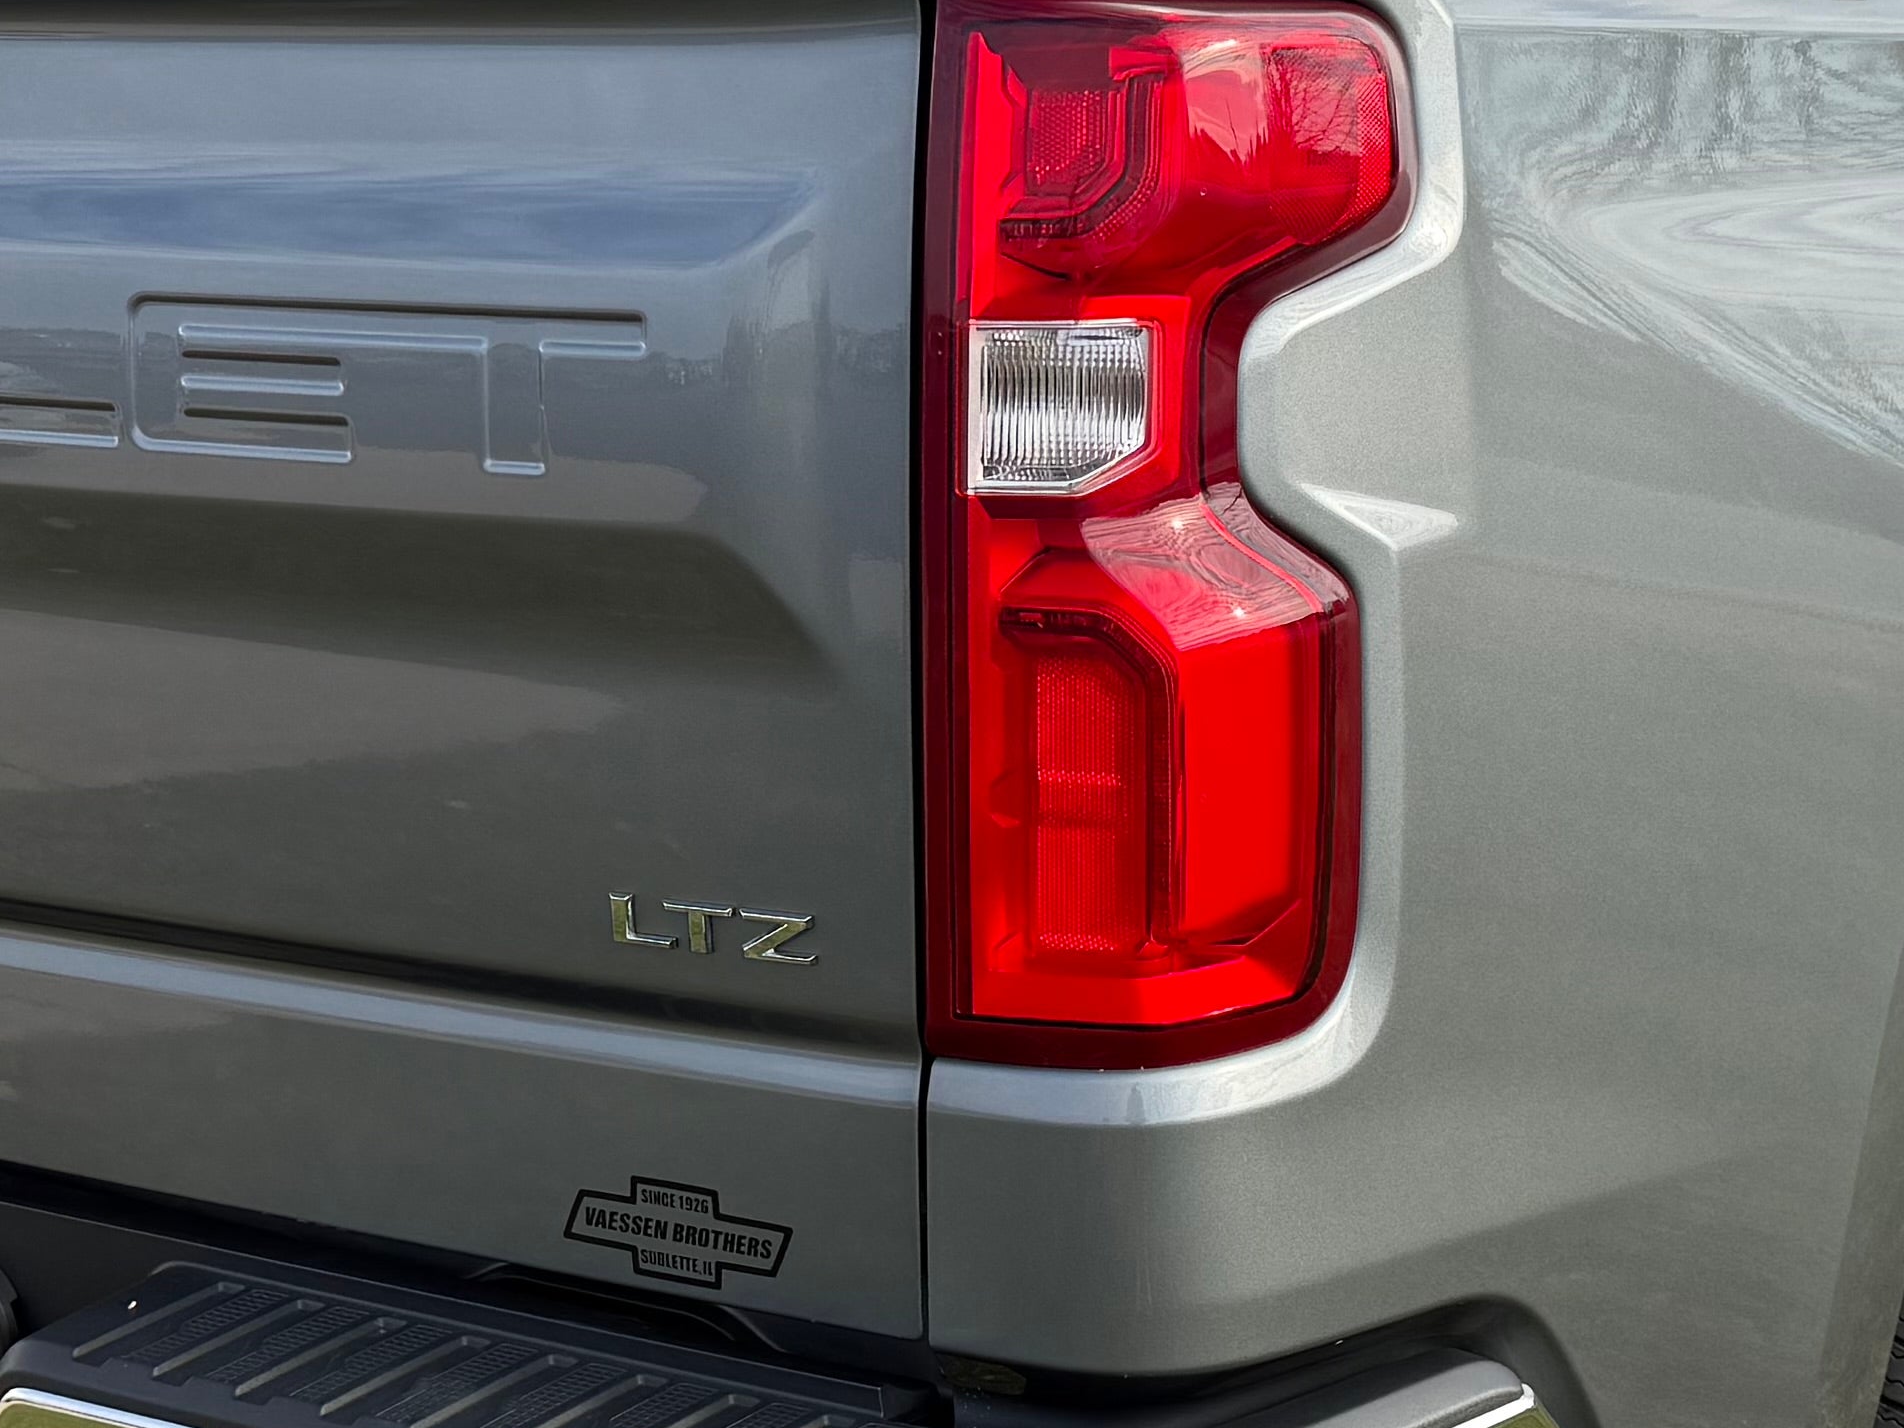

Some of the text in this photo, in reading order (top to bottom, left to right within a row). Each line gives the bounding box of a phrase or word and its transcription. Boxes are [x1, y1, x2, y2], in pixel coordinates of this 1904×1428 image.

[607, 890, 819, 965] LTZ
[640, 1188, 709, 1215] SINCE 1926
[584, 1206, 773, 1260] VAESSEN BROTHERS
